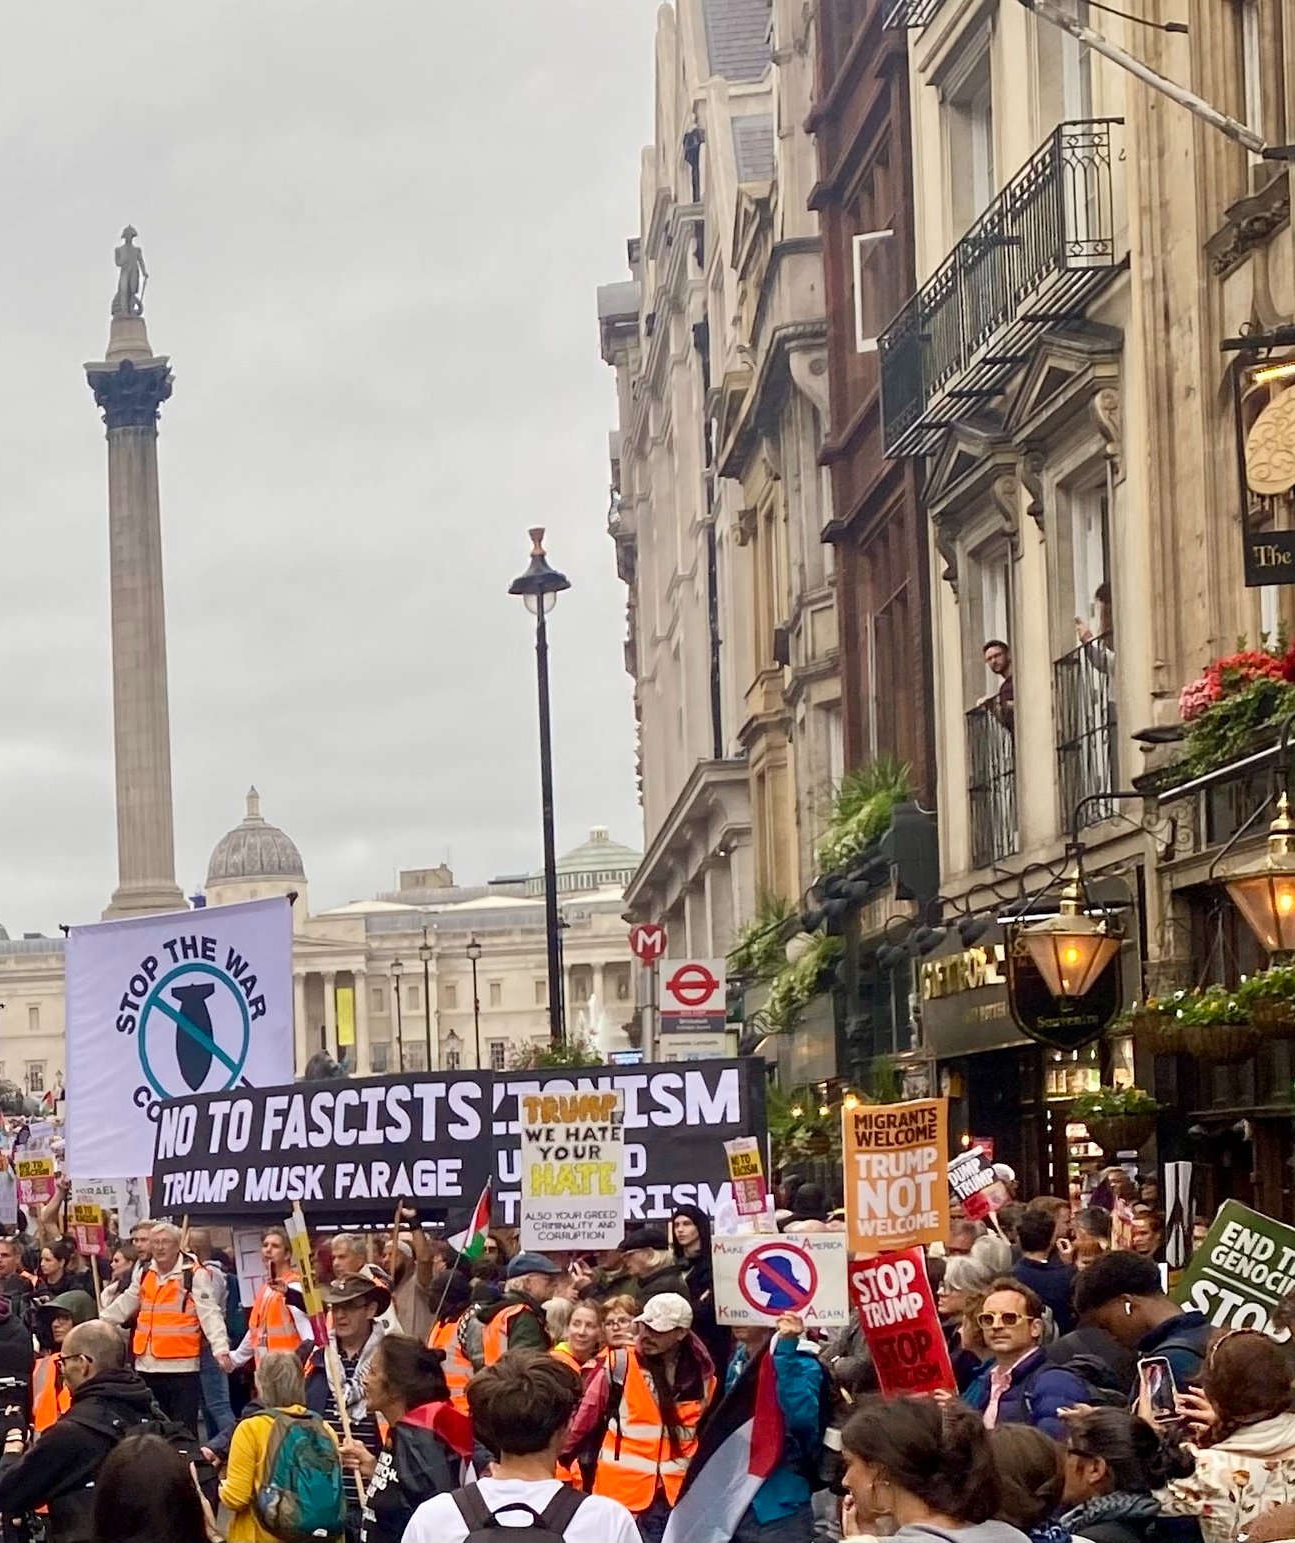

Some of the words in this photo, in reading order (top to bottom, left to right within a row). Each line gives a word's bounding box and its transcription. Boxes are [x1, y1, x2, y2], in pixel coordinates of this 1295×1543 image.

[1253, 544, 1292, 567] The
[637, 929, 662, 953] M
[116, 955, 159, 1035] STOP
[162, 935, 217, 963] THE
[225, 946, 266, 1022] WAR
[157, 1104, 198, 1160] NO
[208, 1099, 254, 1154] TO
[260, 1080, 482, 1151] FASCISTS
[523, 1093, 618, 1125] TRUMP
[854, 1107, 938, 1130] MIGRANTS
[525, 1127, 555, 1142] WE
[565, 1126, 621, 1141] HATE
[855, 1123, 938, 1147] WELCOME
[33, 1160, 43, 1168] TO
[537, 1145, 602, 1161] YOUR
[740, 1153, 751, 1163] TO
[854, 1147, 938, 1178] TRUMP
[162, 1169, 240, 1207] TRUMP
[244, 1164, 325, 1201] MUSK
[335, 1158, 462, 1199] FARAGE
[531, 1162, 617, 1197] HATE
[948, 1157, 981, 1187] DUMP
[955, 1167, 995, 1200] TRUMP
[856, 1172, 938, 1219] NOT
[525, 1211, 551, 1220] ALSO
[555, 1211, 582, 1220] YOUR
[584, 1210, 617, 1219] GREED
[533, 1221, 593, 1230] CRIMINALITY
[598, 1221, 616, 1229] AND
[856, 1211, 939, 1237] WELCOME
[537, 1231, 605, 1240] CORRUPTION
[1219, 1220, 1276, 1262] END
[852, 1260, 916, 1304] STOP
[1210, 1245, 1295, 1296] GENOCI
[862, 1292, 924, 1329] TRUMP
[873, 1329, 933, 1369] STOP
